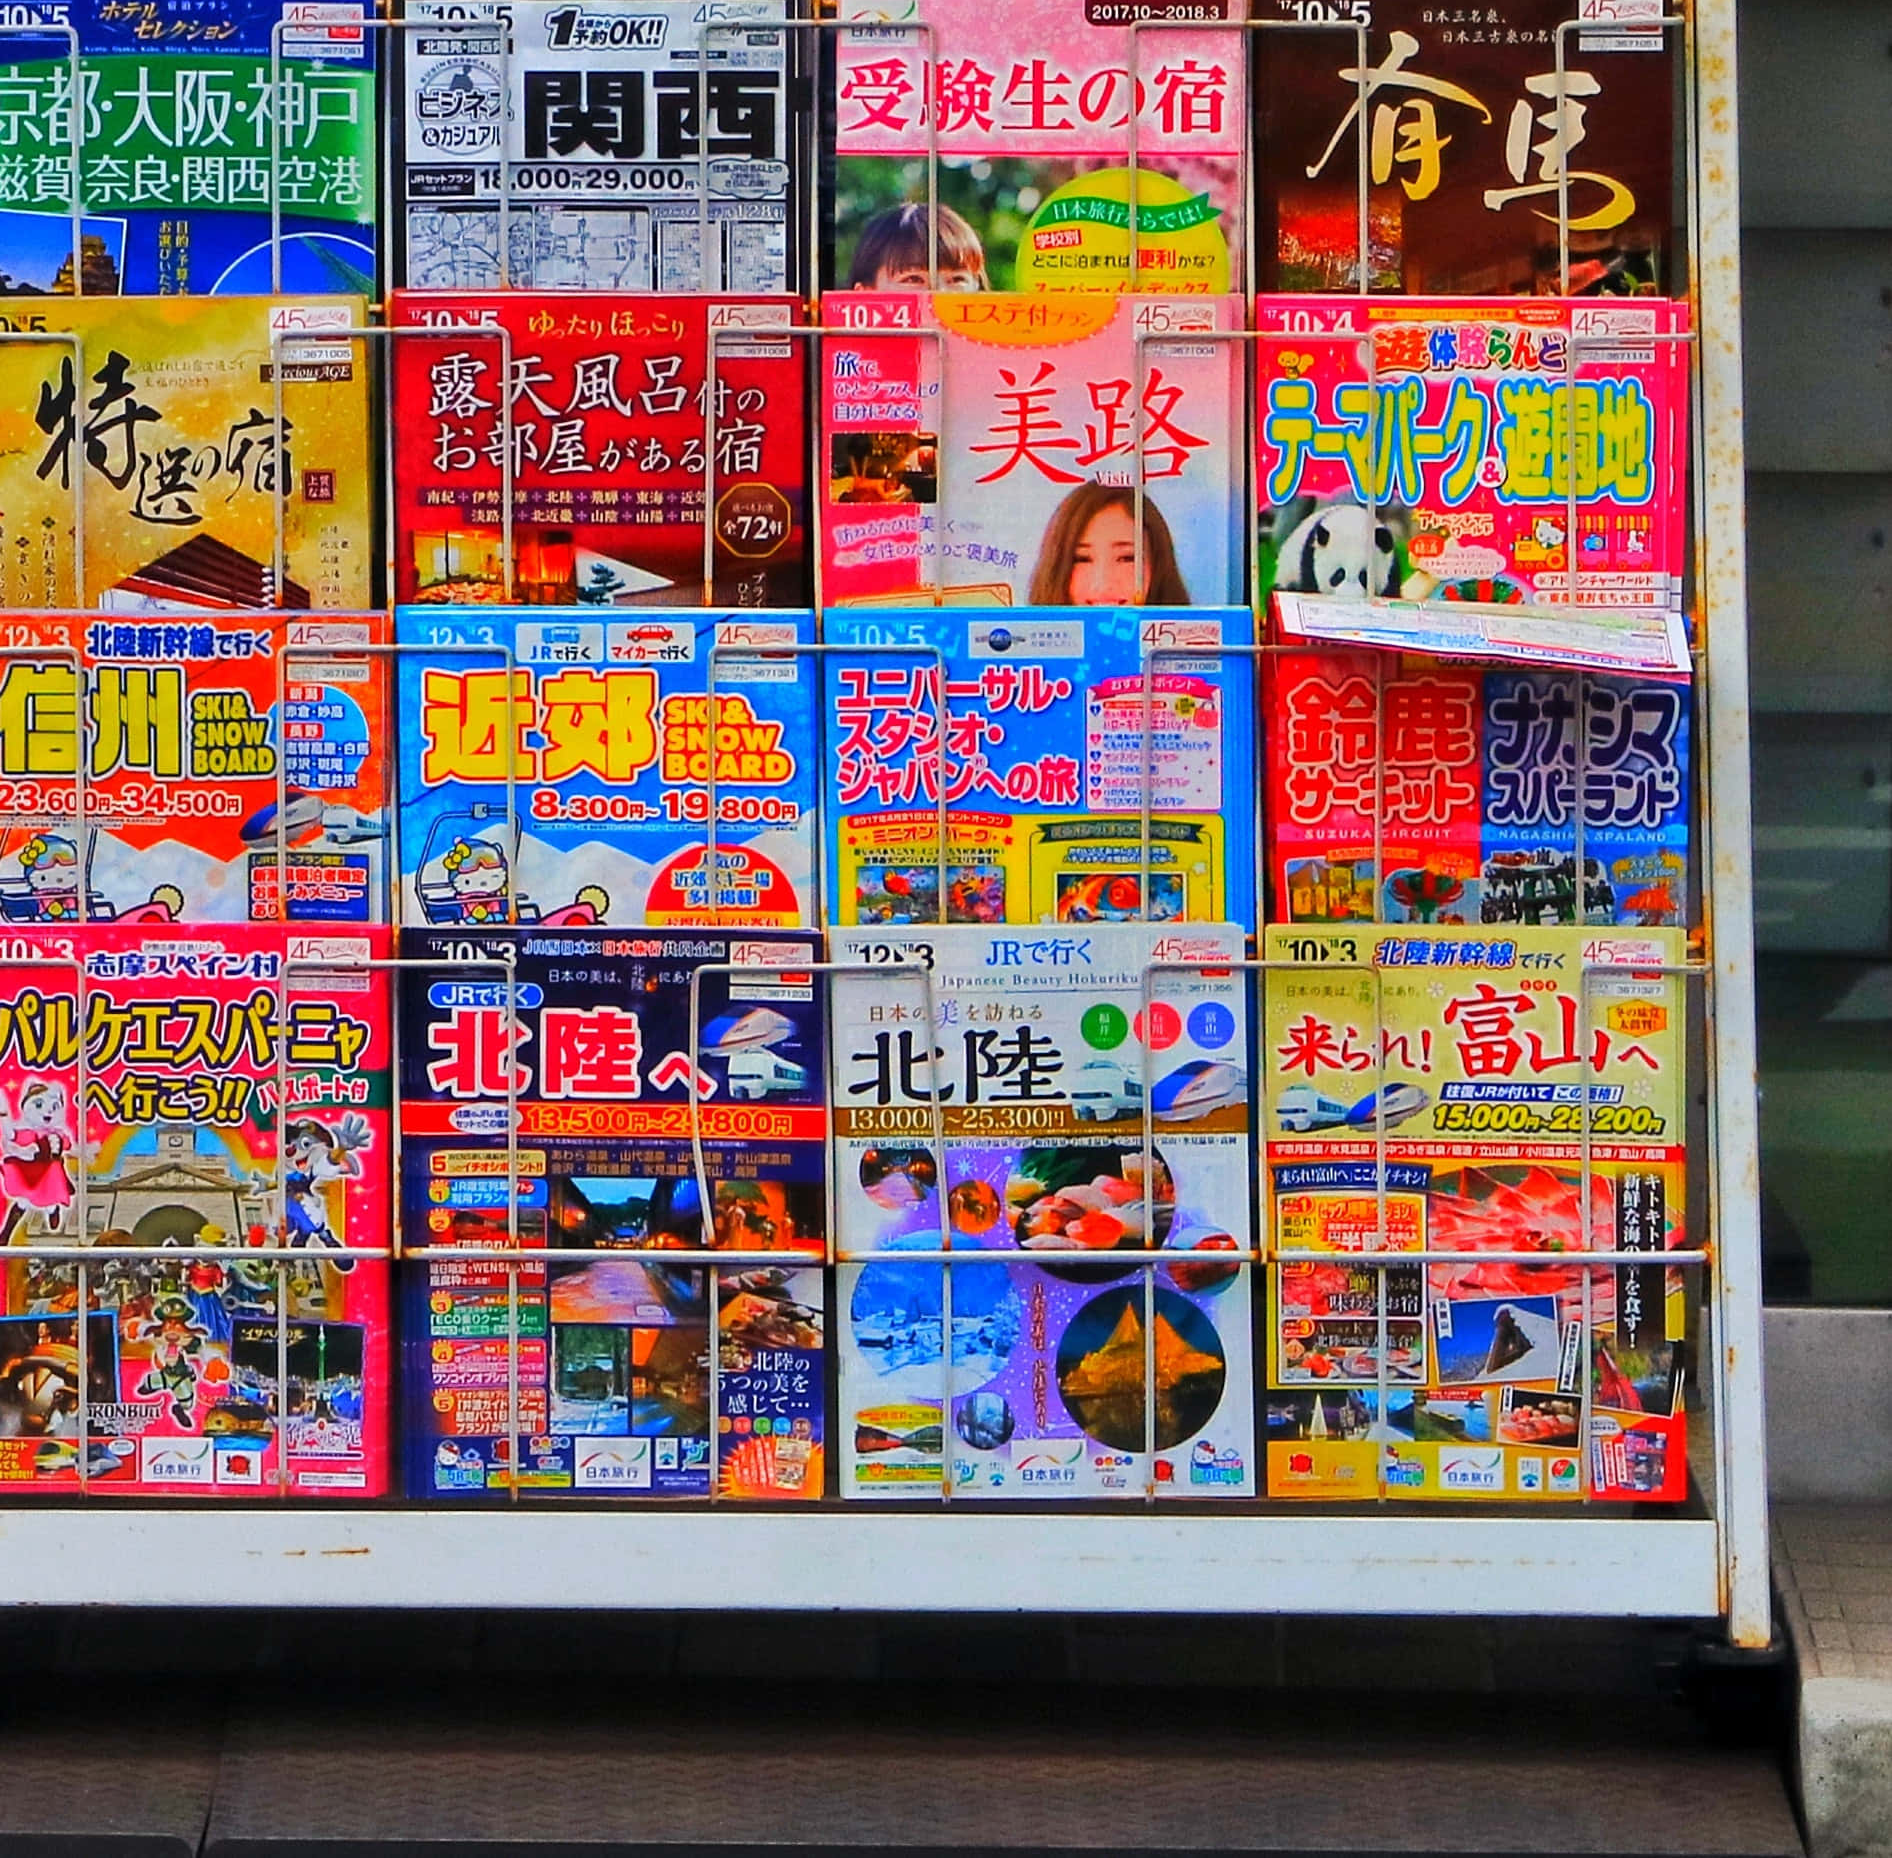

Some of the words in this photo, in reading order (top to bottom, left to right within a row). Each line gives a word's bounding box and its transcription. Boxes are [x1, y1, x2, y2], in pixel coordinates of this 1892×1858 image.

[523, 70, 780, 159] 関西
[841, 58, 1227, 135] 受験生の宿
[1306, 31, 1636, 230] 有馬
[953, 303, 1092, 327] エステ付プラン
[432, 419, 761, 476] お部屋がある宿
[971, 363, 1211, 489] 美路
[87, 625, 272, 660] 北陸新幹線で行く
[609, 643, 690, 662] マイカーで行く
[193, 722, 268, 748] SNOW
[422, 670, 658, 784] 近郊
[1290, 676, 1475, 773] 鈴鹿
[193, 748, 275, 776] BOARD
[1288, 770, 1477, 825] サーキット
[1486, 770, 1680, 831] スパーランド
[85, 950, 279, 979] 志摩スペイン村
[985, 939, 1091, 967] JRで行く
[941, 974, 999, 992] Japanese
[1005, 972, 1057, 991] Beauty
[1064, 972, 1140, 989] Hokuriku
[851, 1027, 1066, 1106] 北陸
[1018, 1466, 1077, 1482] 日本旅行
